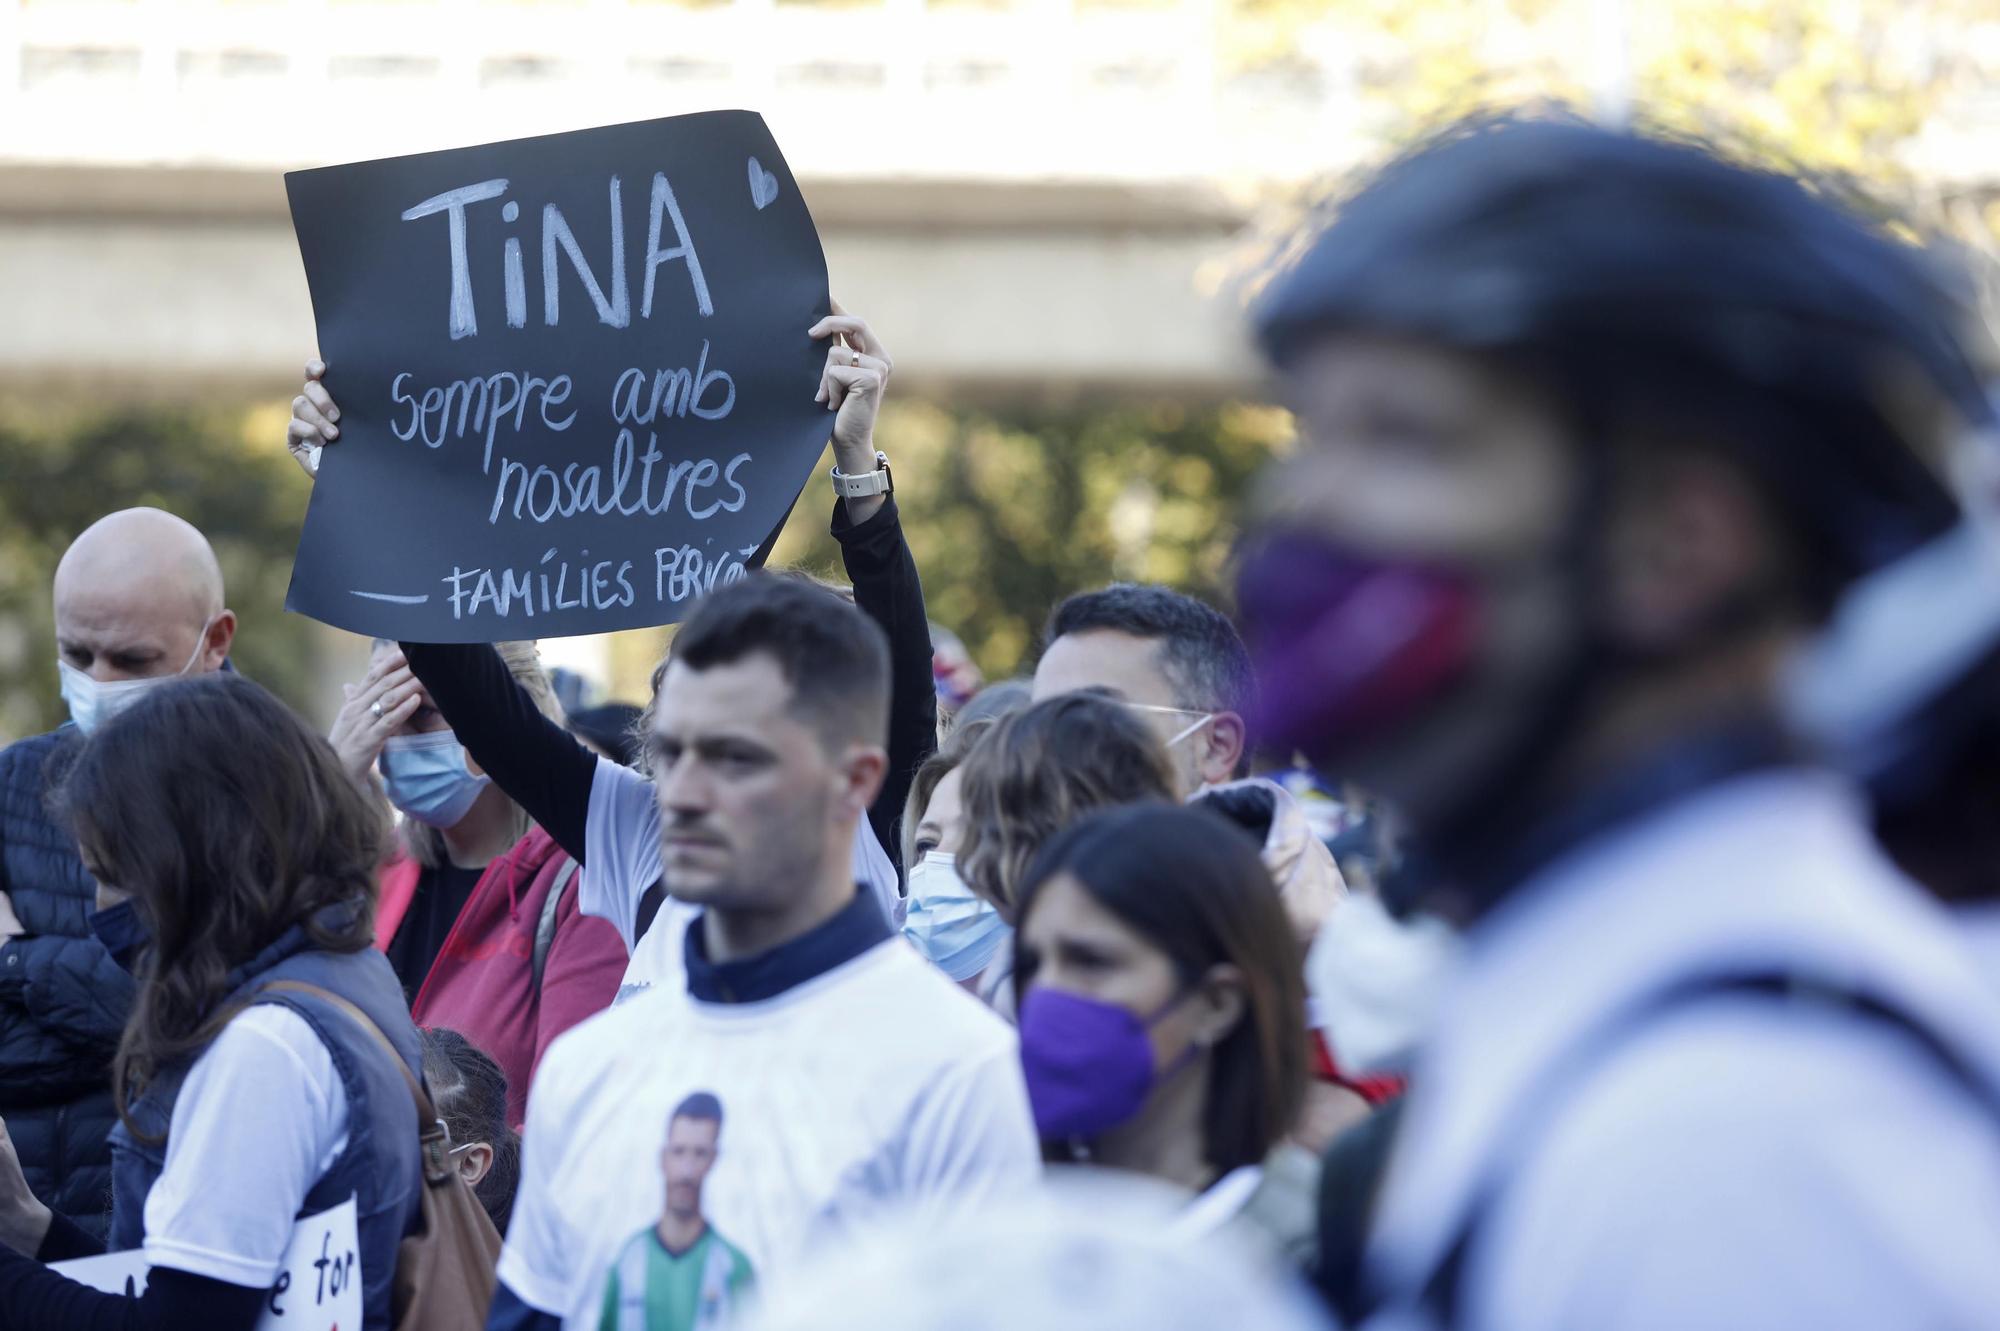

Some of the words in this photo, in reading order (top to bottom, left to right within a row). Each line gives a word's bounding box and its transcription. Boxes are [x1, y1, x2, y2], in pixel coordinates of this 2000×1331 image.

[612, 338, 736, 424] amb
[488, 427, 752, 525] nosaltres
[313, 1230, 354, 1306] for
